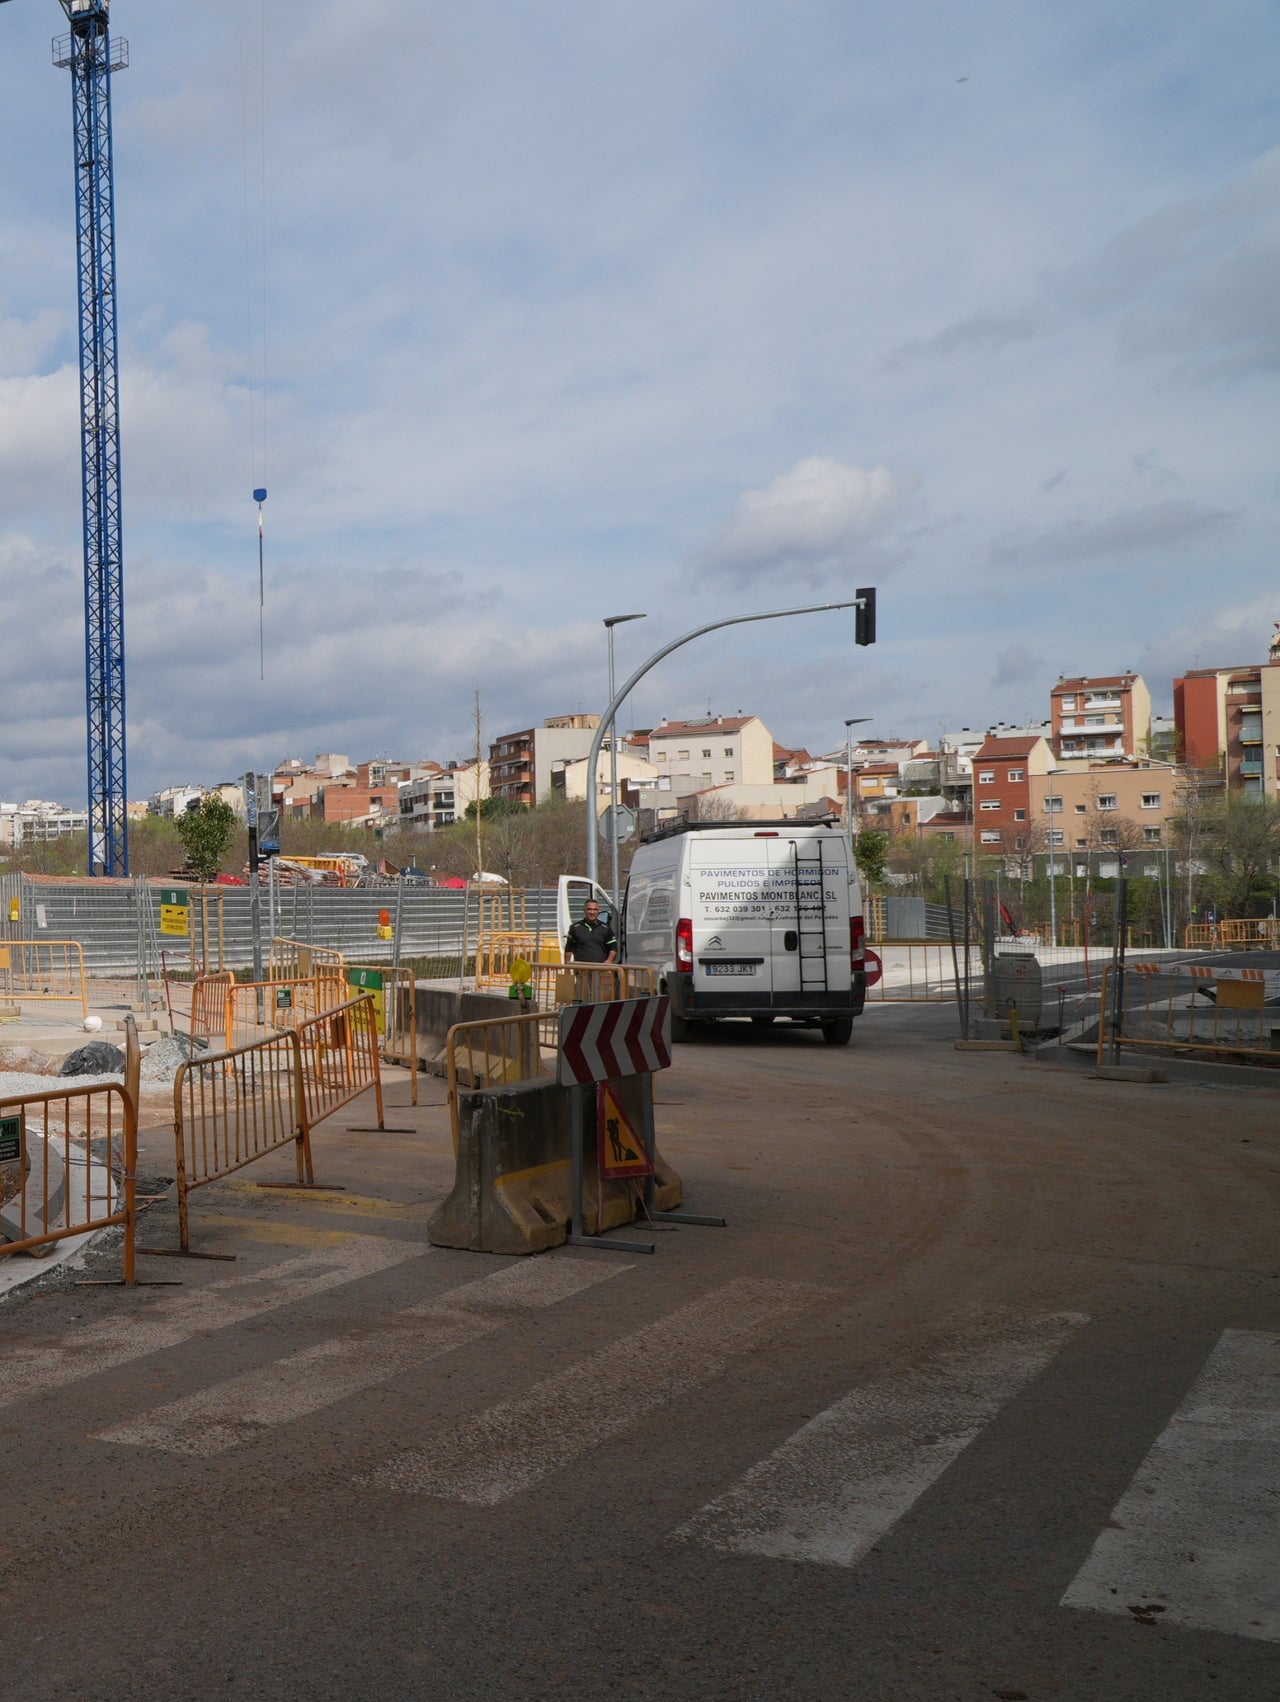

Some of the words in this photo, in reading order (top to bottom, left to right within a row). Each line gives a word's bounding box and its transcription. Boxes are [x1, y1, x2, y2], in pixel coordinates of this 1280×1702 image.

[768, 869, 781, 877] DE
[717, 880, 761, 888] PULIDOS
[699, 892, 759, 901] PAVIMENTOS
[825, 890, 838, 900] SL
[750, 905, 765, 913] 301
[713, 964, 735, 973] 9233
[738, 964, 754, 973] JKY
